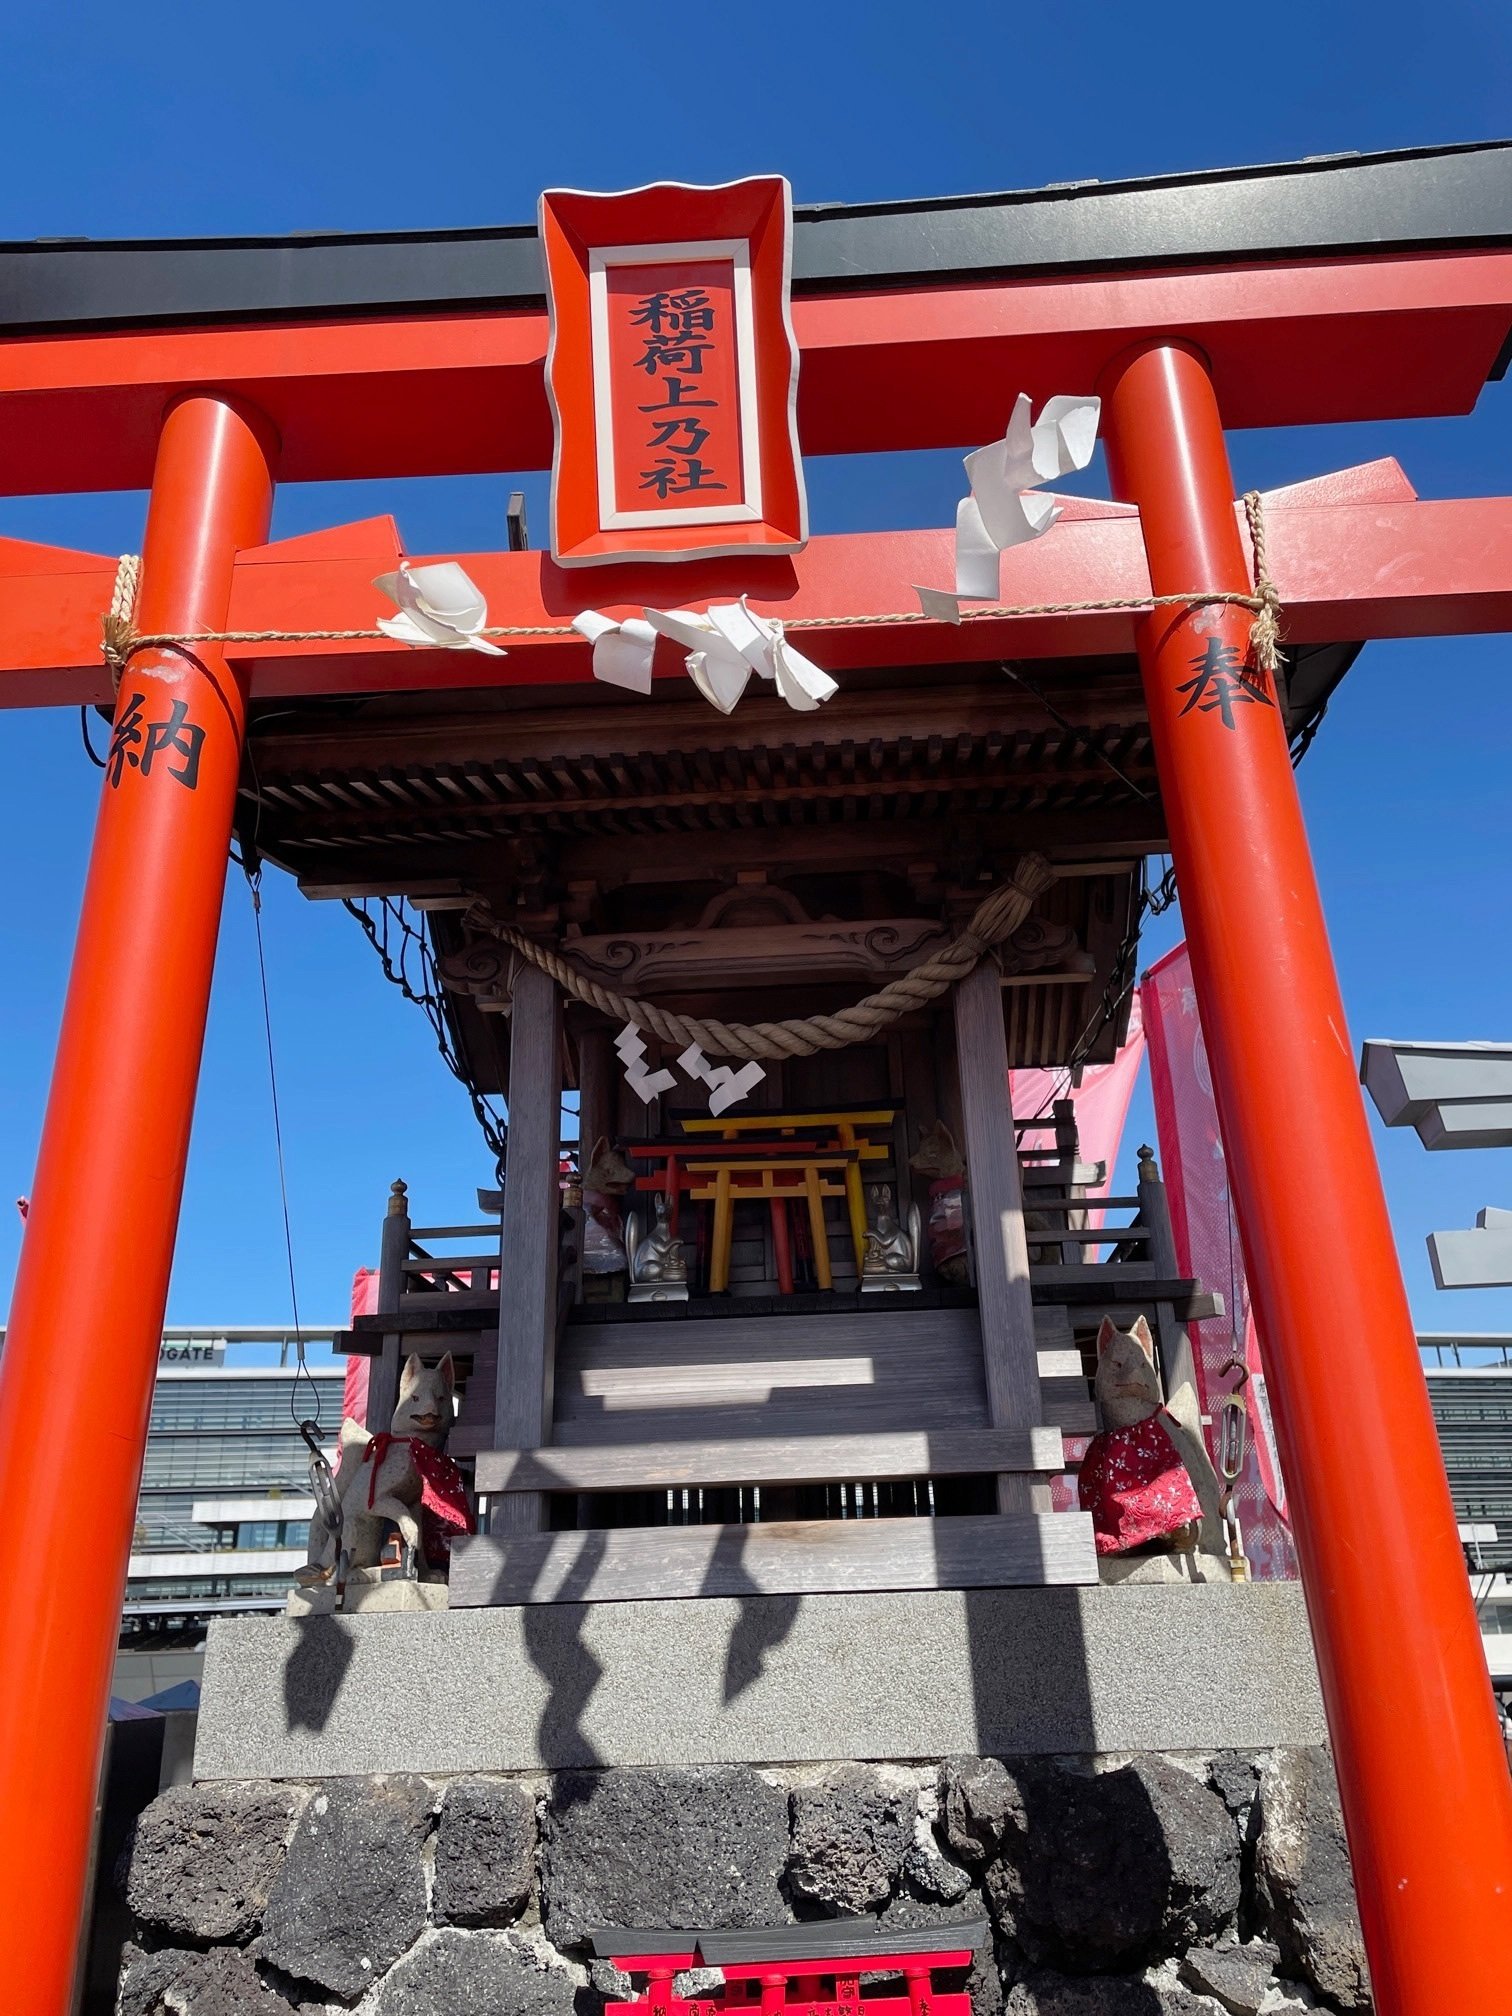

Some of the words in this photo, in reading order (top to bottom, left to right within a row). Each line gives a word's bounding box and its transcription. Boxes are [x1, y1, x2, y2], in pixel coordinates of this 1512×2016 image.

[629, 289, 728, 499] 稲荷上乃社
[1175, 636, 1276, 730] 奉
[107, 693, 206, 790] 納
